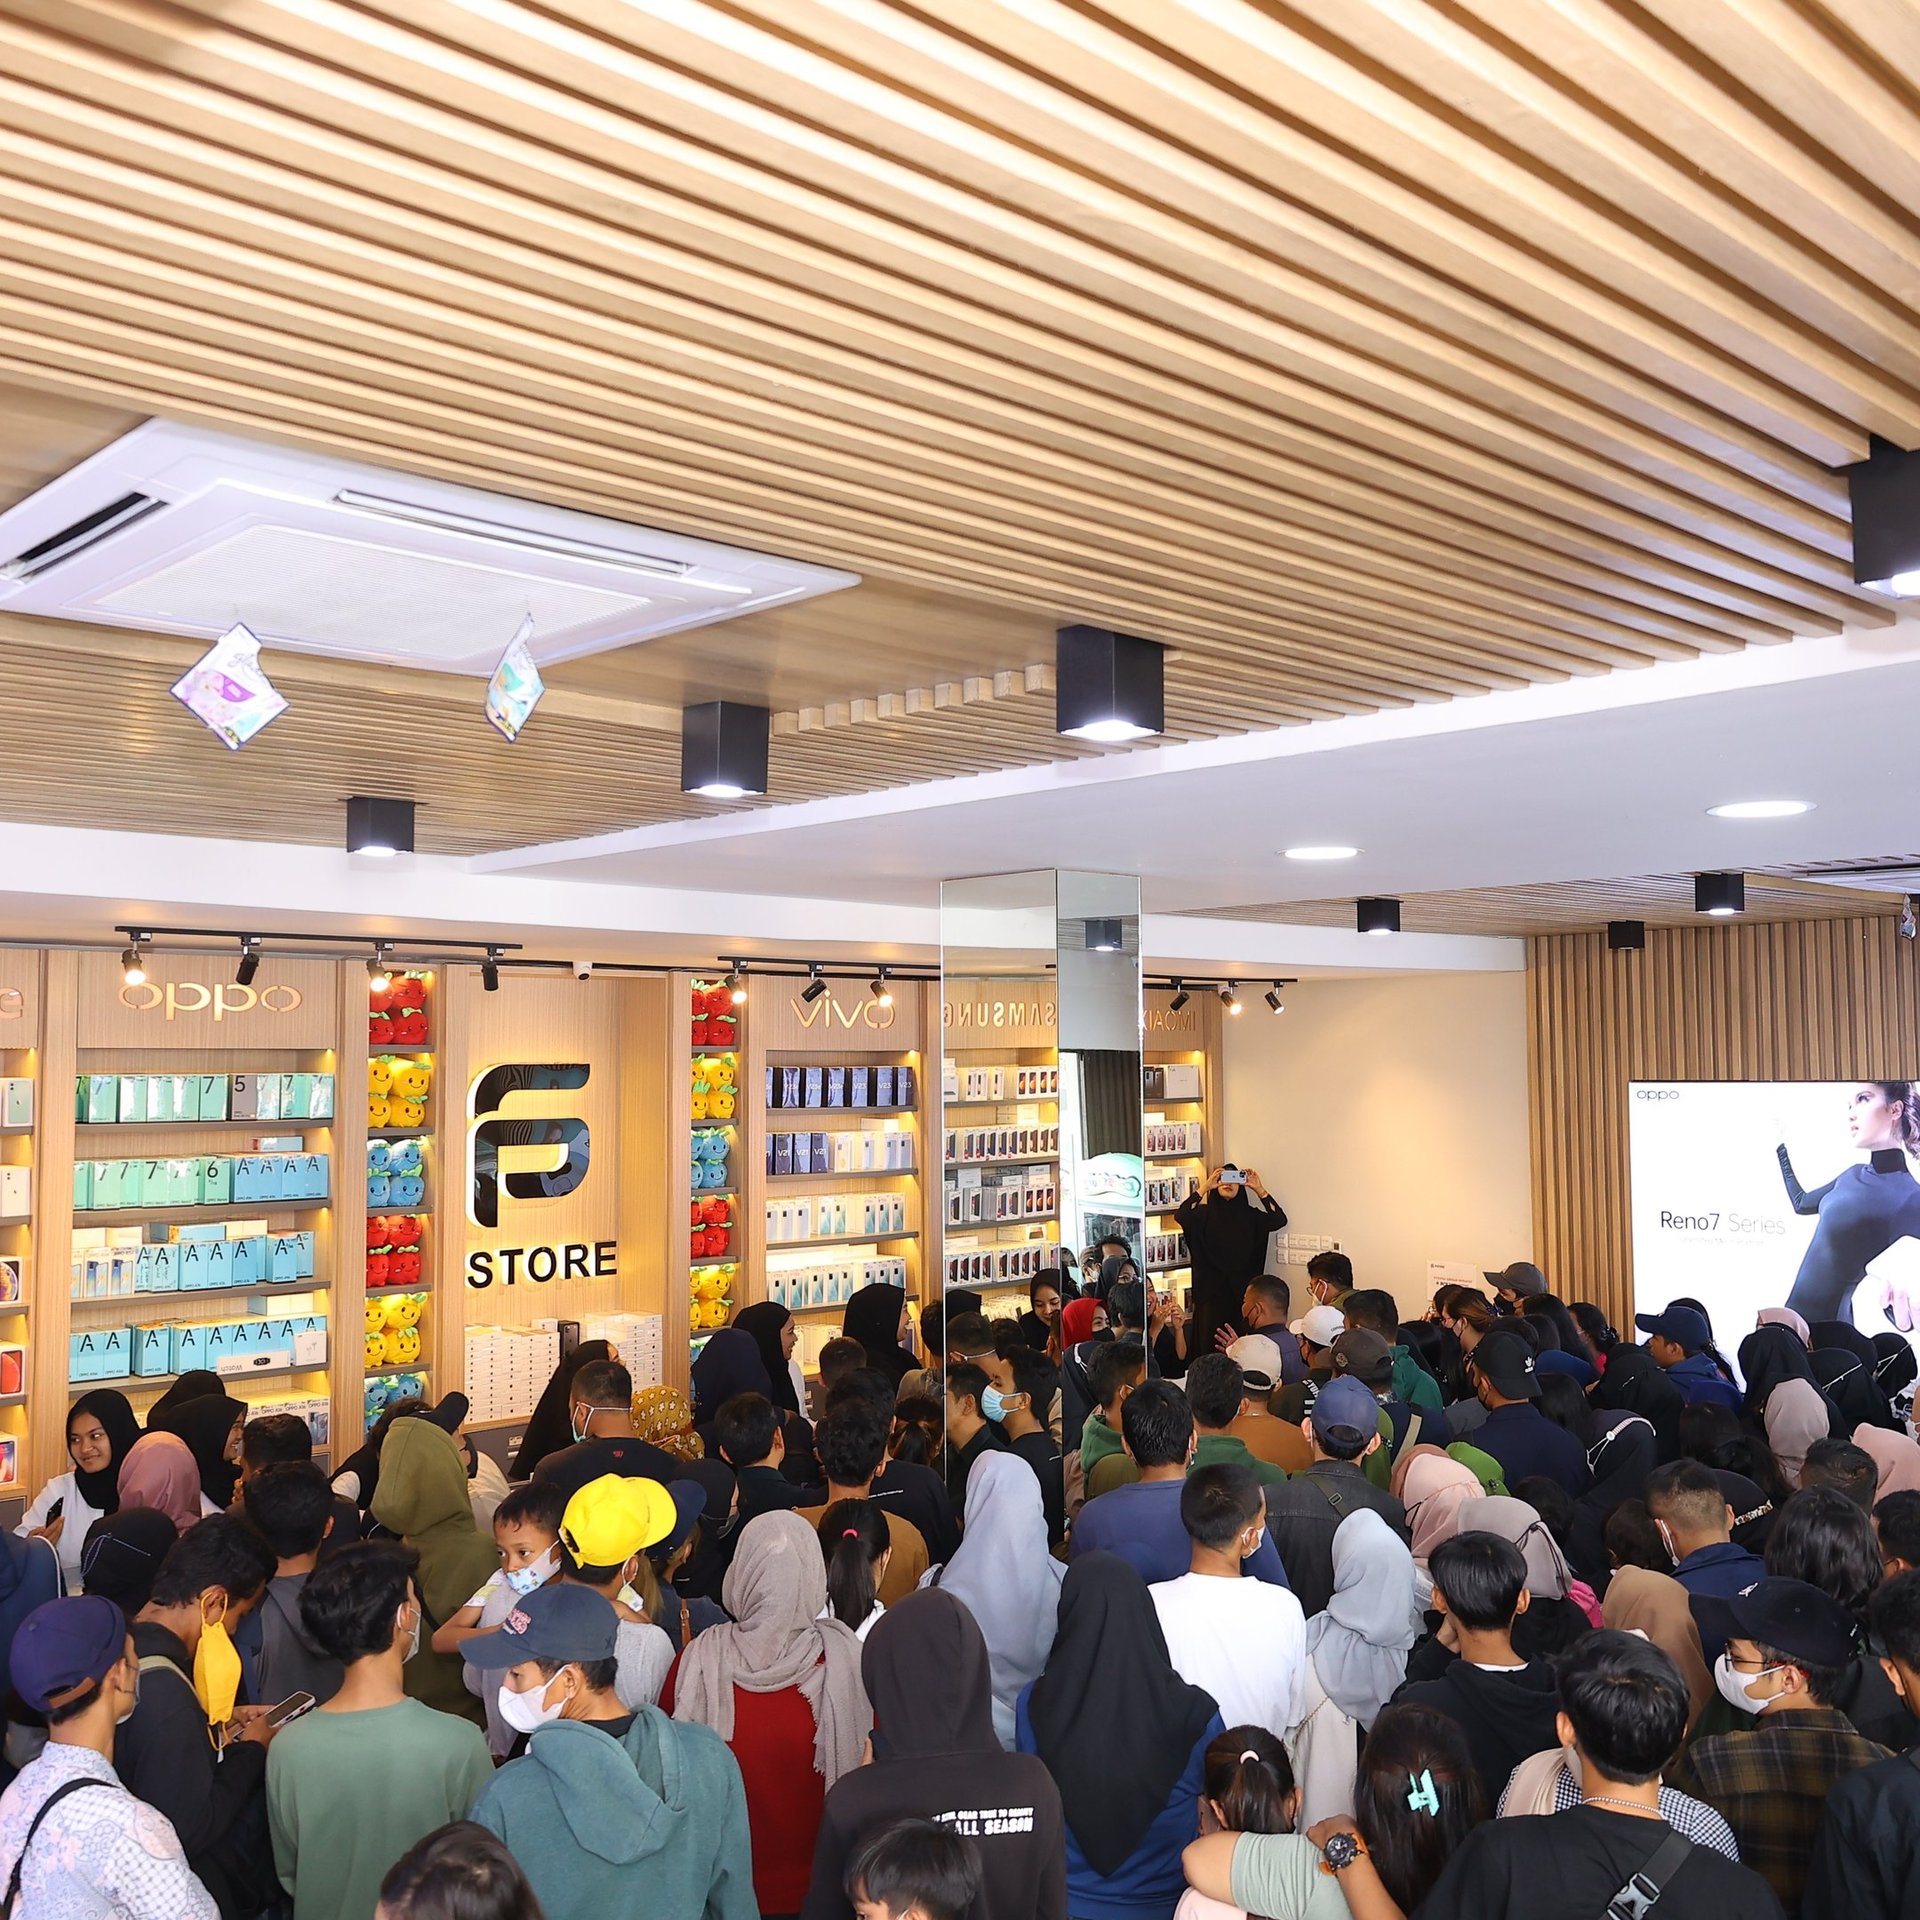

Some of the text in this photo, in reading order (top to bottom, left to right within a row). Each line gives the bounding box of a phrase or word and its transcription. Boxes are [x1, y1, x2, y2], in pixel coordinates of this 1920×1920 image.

[790, 989, 895, 1029] vivo
[202, 1076, 215, 1094] 7
[234, 1075, 246, 1092] 5
[1637, 1090, 1679, 1101] oppo
[146, 1161, 158, 1180] 7
[207, 1160, 219, 1178] 6
[1660, 1210, 1786, 1235] Reno7 Series
[137, 1247, 149, 1264] A
[155, 1247, 169, 1265] A
[186, 1244, 199, 1262] A
[210, 1243, 223, 1261] A
[235, 1241, 248, 1259] A
[275, 1238, 288, 1256] A
[468, 1240, 617, 1288] STORE
[209, 1327, 222, 1345] A
[234, 1325, 247, 1342] A
[258, 1322, 271, 1340] A
[281, 1320, 293, 1337] A
[80, 1334, 94, 1352] A
[106, 1332, 120, 1350] A
[145, 1330, 159, 1348] A
[182, 1329, 195, 1347] A
[984, 1817, 1033, 1835] SEASON
